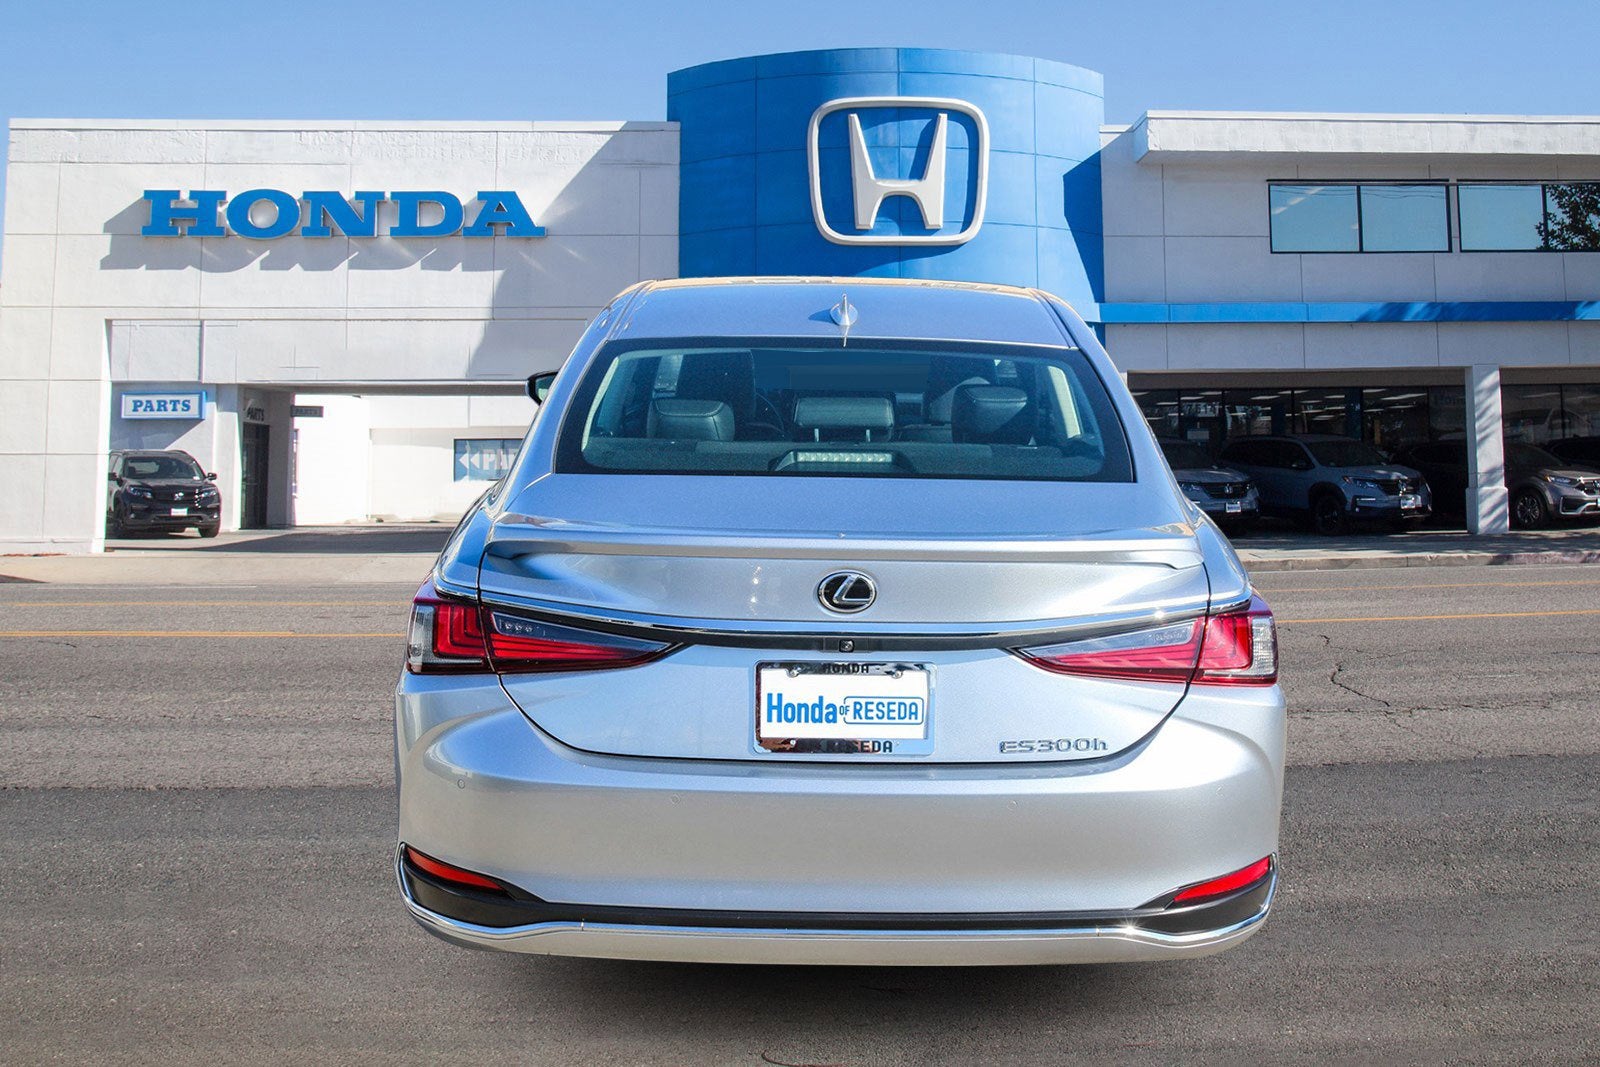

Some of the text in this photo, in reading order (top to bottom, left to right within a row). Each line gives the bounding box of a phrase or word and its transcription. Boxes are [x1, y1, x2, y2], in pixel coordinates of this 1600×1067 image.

[142, 189, 546, 239] HONDA
[132, 400, 191, 413] PARTS
[822, 663, 869, 673] HONDA
[767, 693, 919, 724] Honda OF RESEDA
[1000, 738, 1109, 753] ES300h
